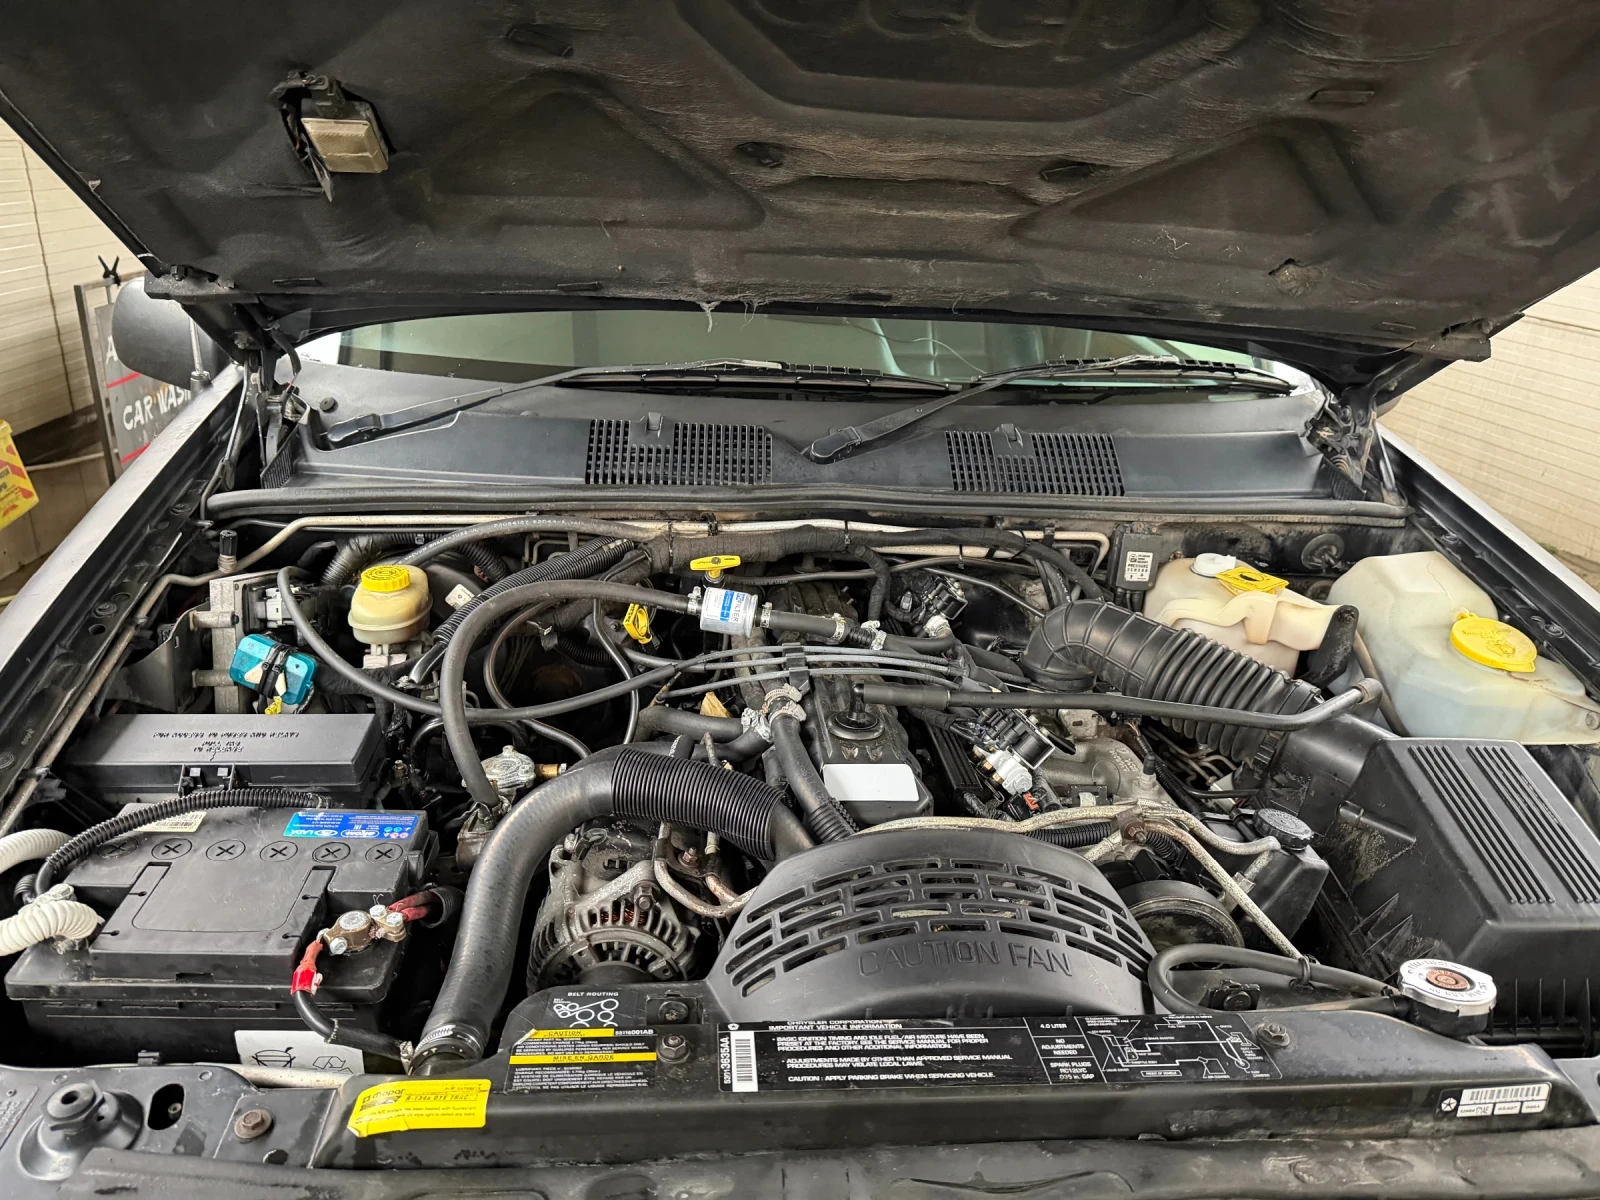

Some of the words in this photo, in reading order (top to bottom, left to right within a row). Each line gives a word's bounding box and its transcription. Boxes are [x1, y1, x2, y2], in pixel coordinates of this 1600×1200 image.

[122, 395, 154, 430] CAR
[404, 548, 427, 560] VACUUM
[858, 940, 1000, 977] CAUTION
[1008, 942, 1073, 977] FAN
